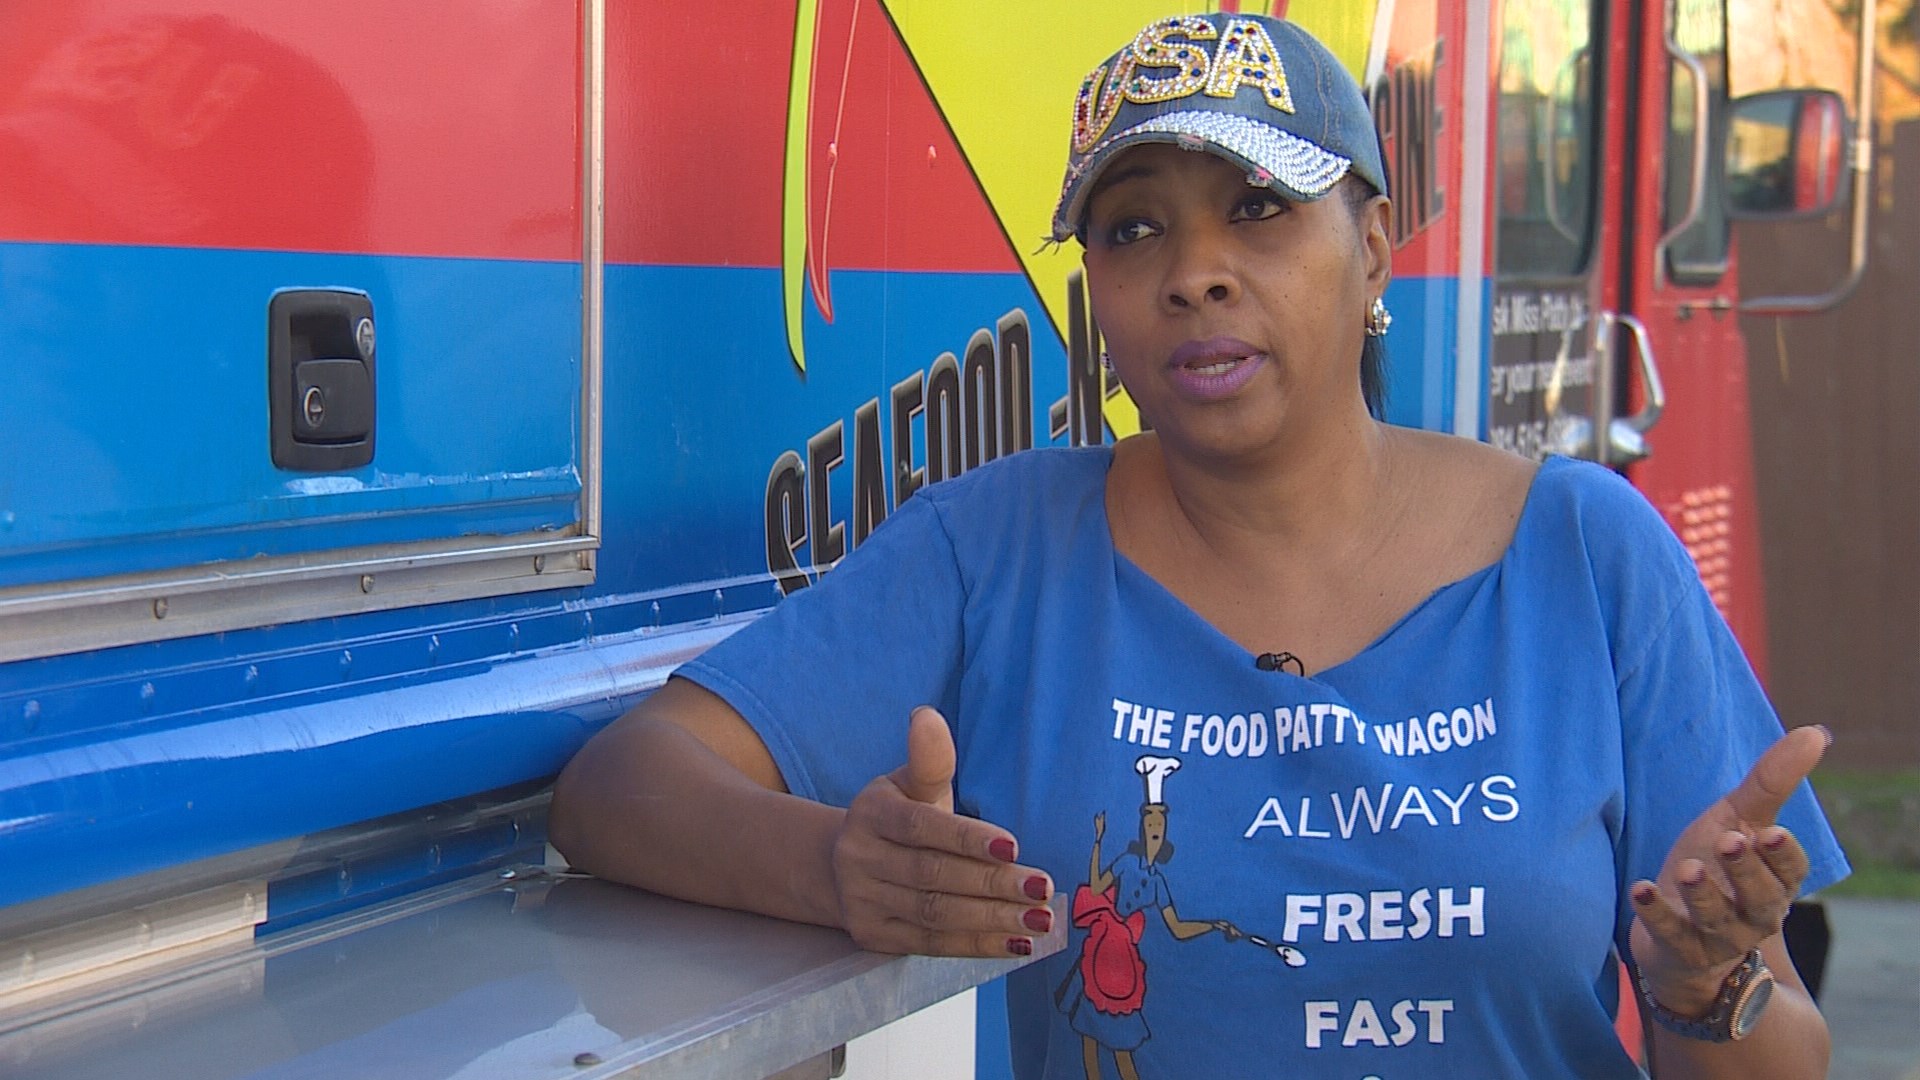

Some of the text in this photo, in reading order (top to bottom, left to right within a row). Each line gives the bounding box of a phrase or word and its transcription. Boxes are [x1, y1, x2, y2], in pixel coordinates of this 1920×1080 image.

[1073, 15, 1295, 152] USA
[1511, 294, 1540, 333] Miss
[1112, 698, 1496, 757] THE FOOD PATTY WAGON
[1244, 775, 1520, 839] ALWAYS
[1282, 887, 1485, 942] FRESH
[1305, 1000, 1454, 1048] FAST
